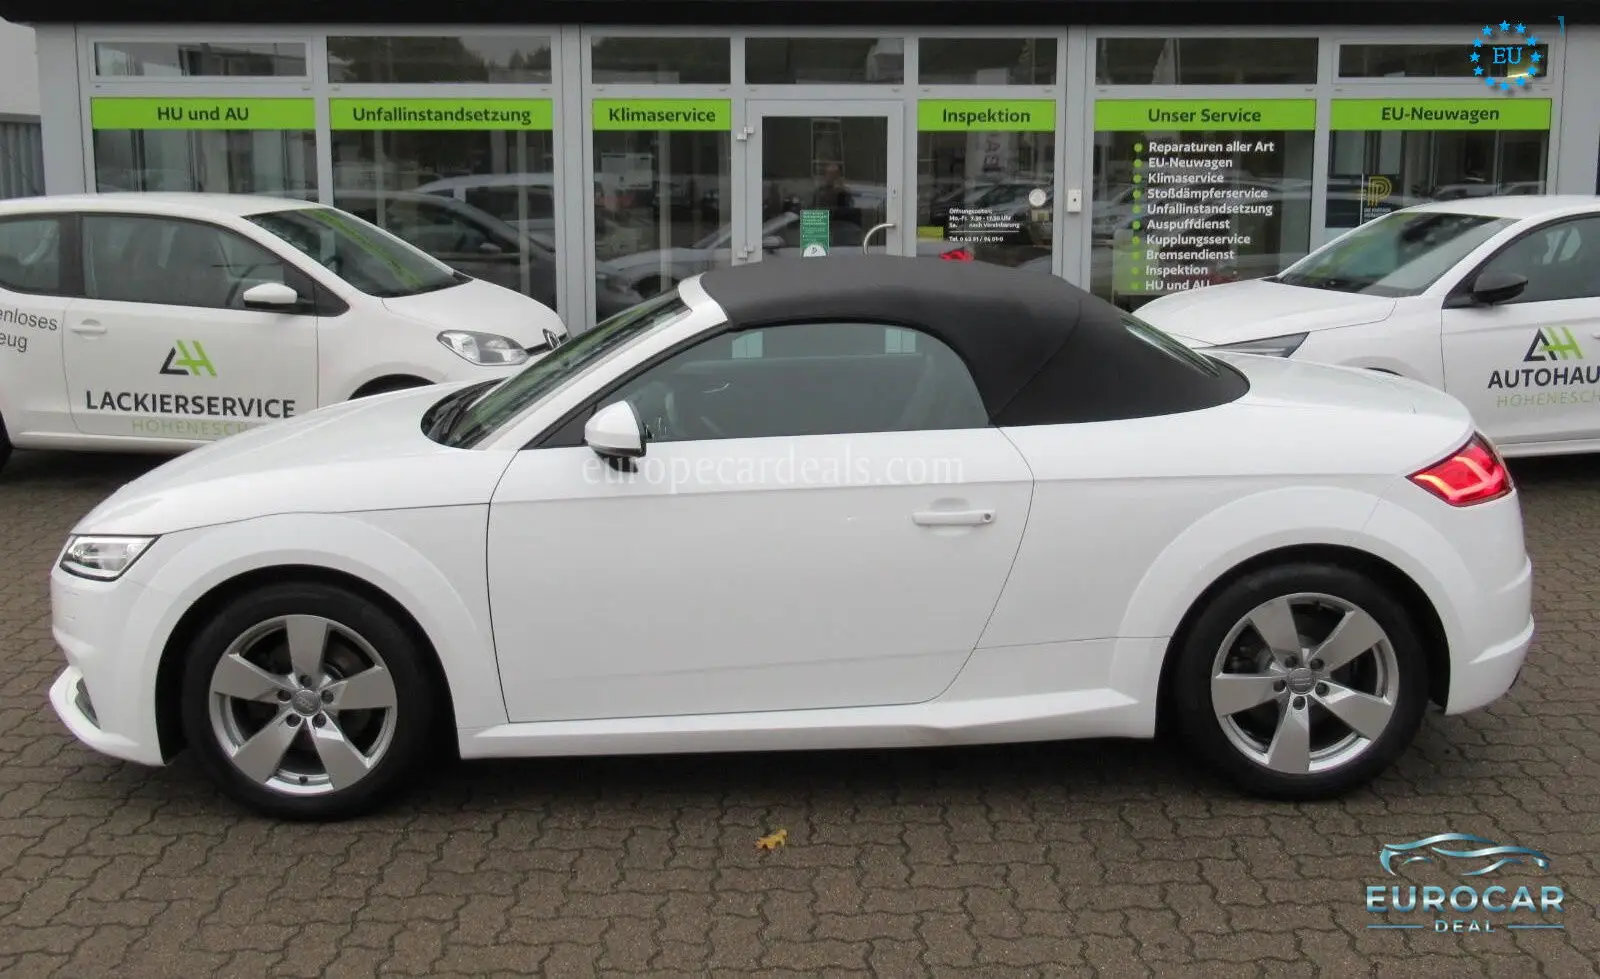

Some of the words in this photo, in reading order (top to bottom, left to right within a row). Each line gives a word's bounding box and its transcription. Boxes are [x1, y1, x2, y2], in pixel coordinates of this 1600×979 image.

[157, 107, 183, 121] HU
[188, 106, 220, 121] und
[224, 107, 249, 121] AU
[352, 106, 532, 126] Unfallinstandsetzung
[608, 106, 716, 123] Klimaservice
[942, 107, 1031, 127] Inspektion
[1147, 108, 1197, 123] Unser
[1200, 107, 1262, 123] Service
[1381, 106, 1500, 125] EU-Neuwagen
[1148, 142, 1223, 155] Reparaturen
[1226, 141, 1252, 152] aller
[1255, 141, 1275, 152] Art
[1148, 157, 1233, 170] EU-Neuwagen
[1148, 172, 1224, 184] Klimaservice
[1147, 187, 1269, 201] Stoßdämpferservice
[1147, 203, 1273, 216] Unfallinstandsetzung
[1146, 219, 1230, 232] Auspuffdienst
[1146, 234, 1251, 247] Kupplungsservice
[1146, 250, 1235, 260] Bremsendienst
[1145, 265, 1209, 278] Inspektion
[1145, 281, 1164, 291] HU
[1166, 280, 1190, 290] und
[1487, 366, 1600, 389] AUTOHAU
[86, 390, 296, 419] LACKIERSERVICE
